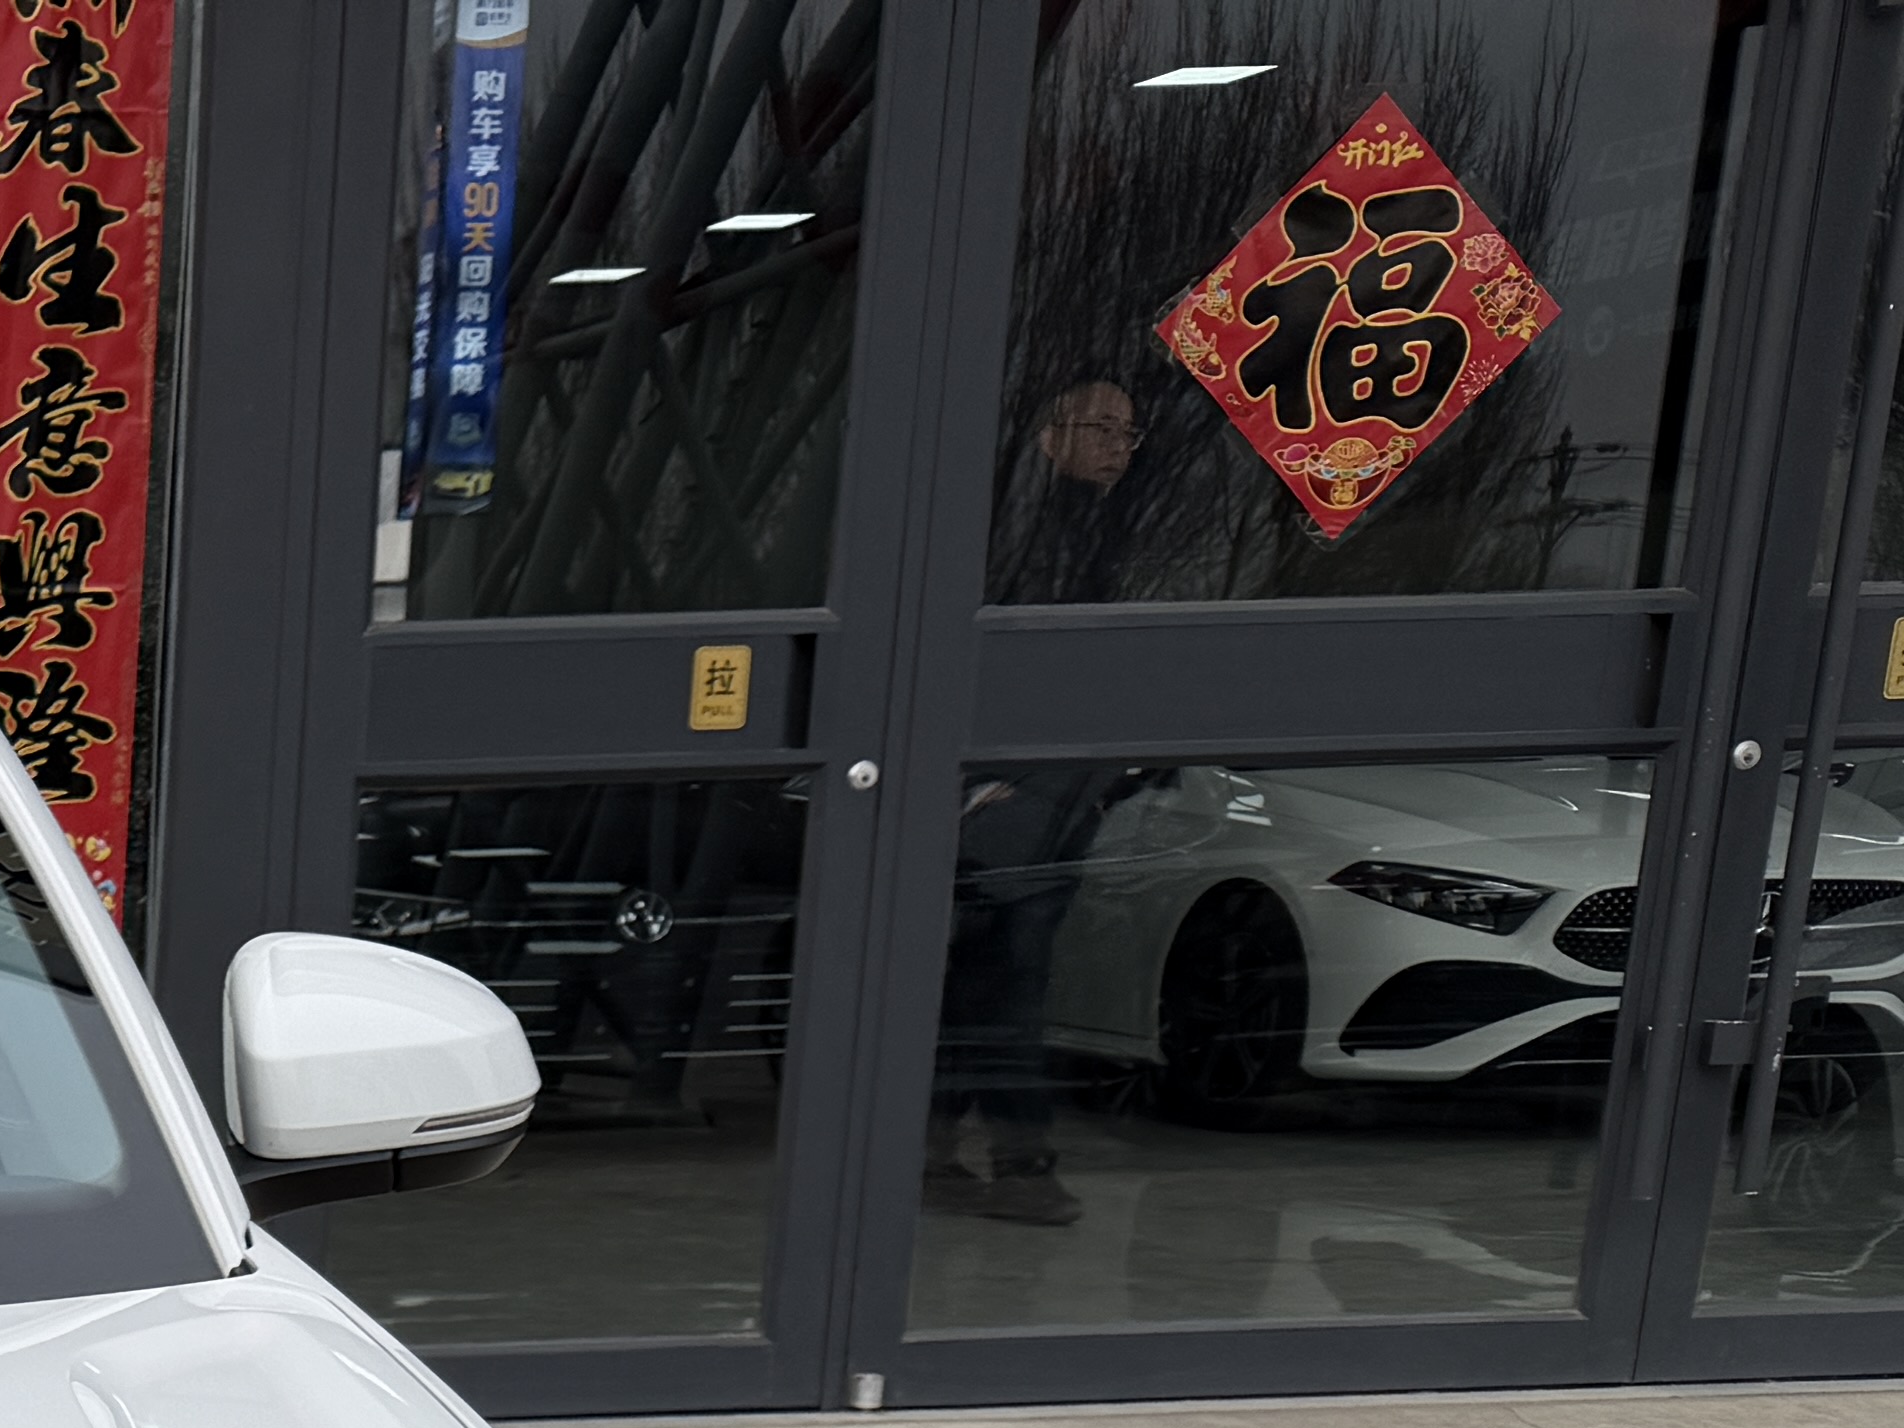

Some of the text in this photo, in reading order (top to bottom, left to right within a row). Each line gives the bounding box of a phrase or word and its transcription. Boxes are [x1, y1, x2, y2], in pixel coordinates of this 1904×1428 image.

[1337, 131, 1425, 170] 开门红
[448, 69, 507, 396] 购车享90天回购保障
[1235, 180, 1470, 433] 福
[704, 659, 738, 697] 拉
